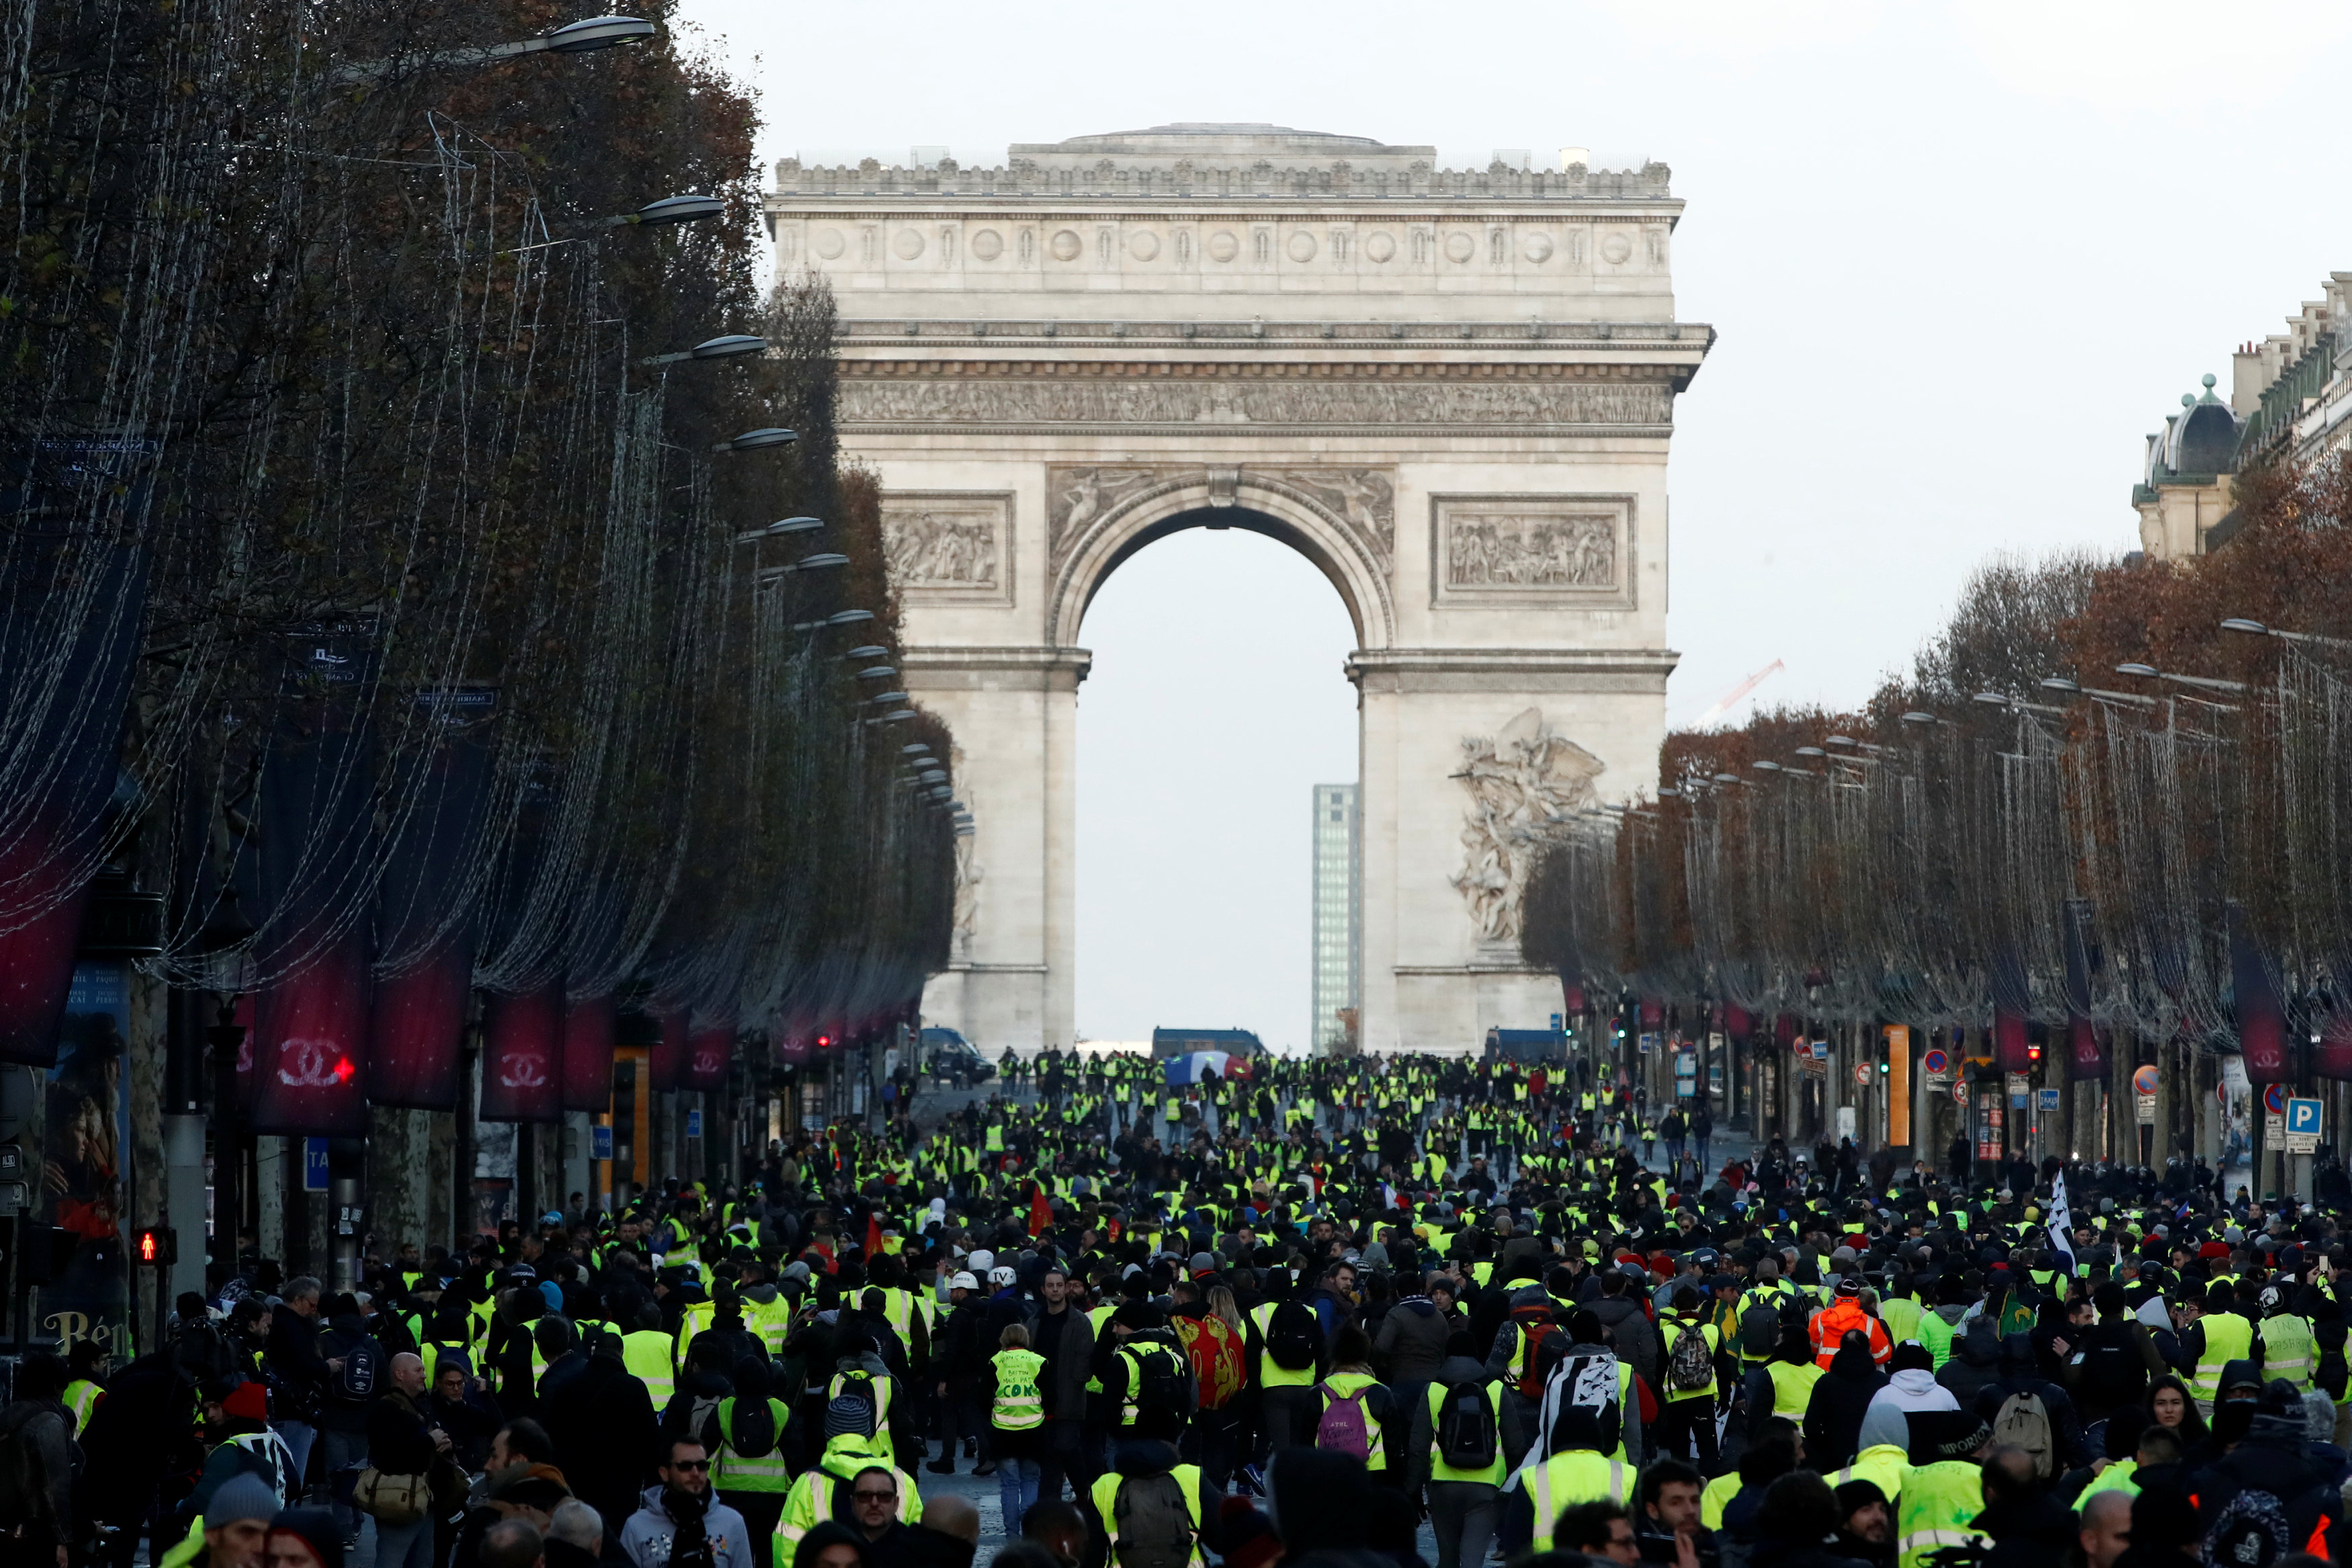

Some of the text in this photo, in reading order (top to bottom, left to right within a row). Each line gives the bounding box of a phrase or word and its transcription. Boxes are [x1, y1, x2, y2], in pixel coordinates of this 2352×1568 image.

[2296, 1105, 2313, 1127] P
[994, 1272, 1007, 1281] TV
[1004, 1385, 1033, 1397] CON
